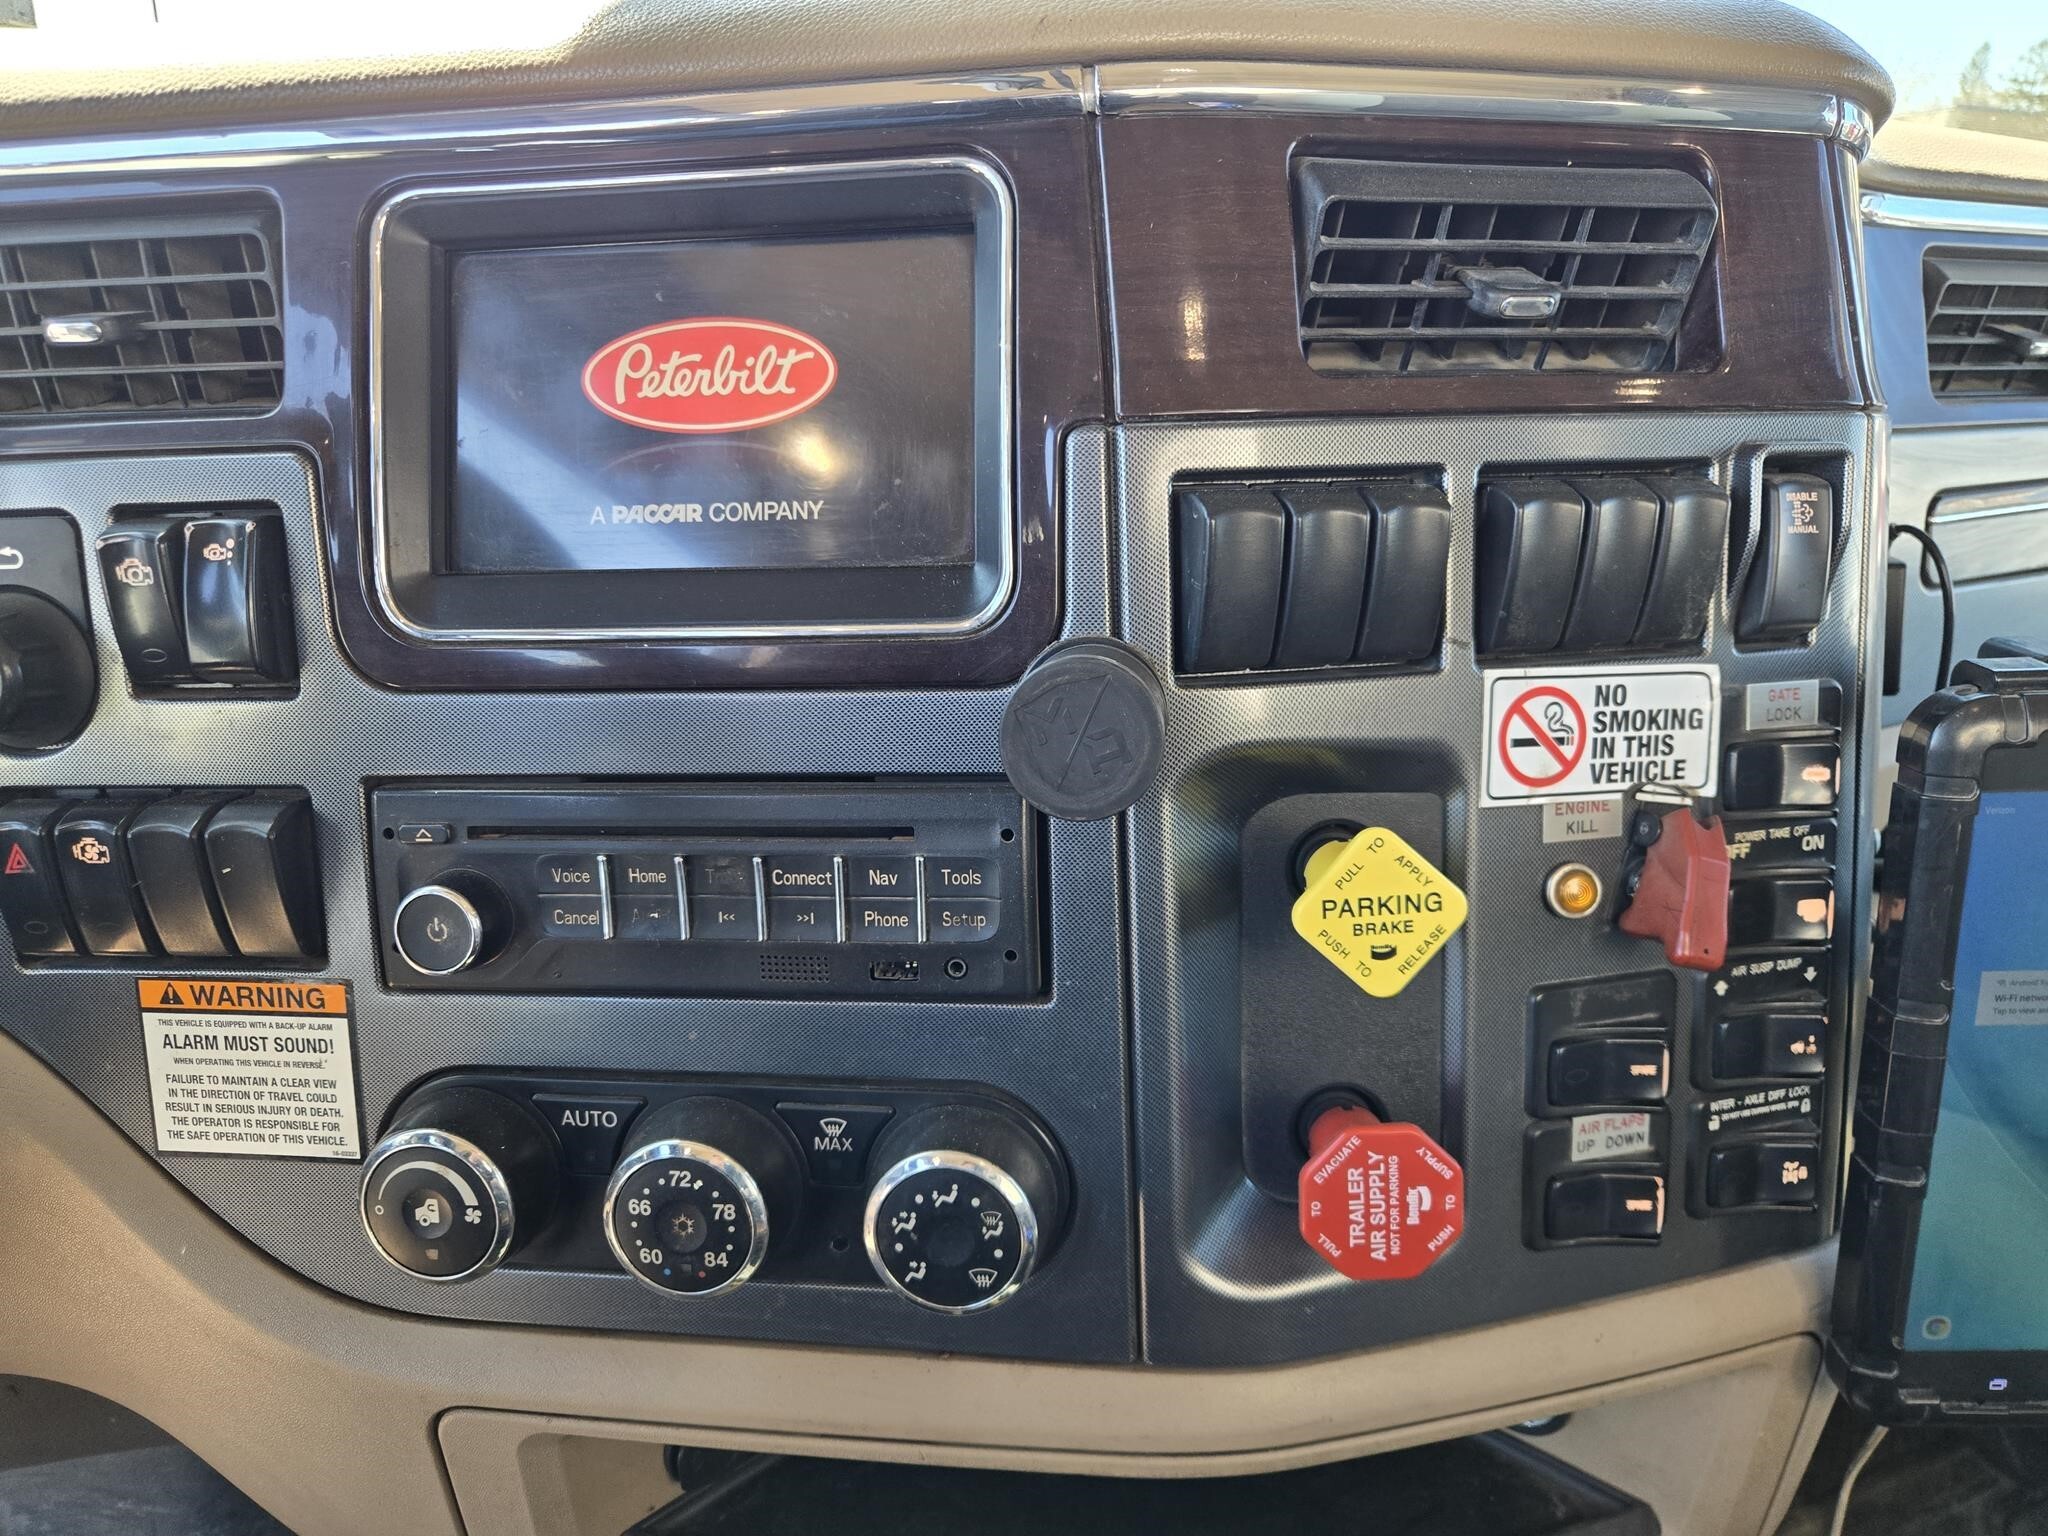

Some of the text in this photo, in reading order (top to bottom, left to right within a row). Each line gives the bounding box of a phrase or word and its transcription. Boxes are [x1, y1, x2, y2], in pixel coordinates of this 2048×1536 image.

[615, 343, 814, 404] Peterbilt
[590, 500, 824, 525] A PACCAR COMPANY
[1787, 525, 1819, 533] MANUAL
[1594, 683, 1627, 707] NO
[1768, 687, 1801, 702] GATE
[1592, 708, 1704, 733] SMOKING
[1766, 707, 1802, 722] LOCK
[1591, 734, 1675, 759] IN THIS
[1589, 759, 1687, 785] VEHICLE
[1555, 800, 1611, 816] ENGINE
[1566, 820, 1599, 835] KILL
[1734, 824, 1811, 842] POWER TAKE OFF
[1802, 834, 1825, 852] ON
[1335, 837, 1433, 890] PULL TO APPLY
[552, 867, 591, 883] Voice
[628, 868, 667, 883] Home
[772, 869, 833, 886] Connect
[869, 869, 898, 885] Nav
[941, 868, 982, 885] Tools
[1322, 892, 1443, 919] PARKING
[554, 909, 600, 926] Cancel
[864, 911, 909, 927] Phone
[942, 913, 987, 929] Setup
[1353, 919, 1414, 937] BRAKE
[1318, 924, 1447, 978] PUSH TO RELEASE
[1731, 965, 1748, 977] AIR
[1776, 957, 1802, 971] DUMP
[189, 984, 326, 1009] WARNING
[158, 1018, 173, 1027] THIS
[175, 1019, 203, 1027] VEHICLE
[213, 1020, 247, 1028] EQUIPPED
[249, 1021, 267, 1029] WITH
[275, 1022, 306, 1030] BACK-UP
[308, 1023, 333, 1031] ALARM
[163, 1033, 334, 1054] ALARM MUST SOUND!
[173, 1057, 194, 1065] WHEN
[195, 1057, 235, 1066] OPERATING
[236, 1059, 252, 1067] THIS
[253, 1059, 283, 1068] VEHICLE
[284, 1060, 291, 1068] IN
[165, 1073, 337, 1089] FAILURE TO MAINTAIN A CLEAR VIEW
[168, 1088, 337, 1103] IN THE DIRECTION OF TRAVEL COULD
[1743, 1091, 1766, 1106] AXLE
[1767, 1088, 1787, 1102] DIFF
[1788, 1084, 1811, 1098] LOCK
[165, 1102, 344, 1118] RESULT IN SERIOUS INJURY OR DEATH.
[171, 1116, 341, 1132] THE OPERATOR IS RESPONSIBLE FOR
[561, 1110, 618, 1129] AUTO
[1578, 1113, 1645, 1136] AIR FLAPS
[167, 1129, 348, 1146] THE SAFE OPERATION OF THIS VEHICLE.
[814, 1136, 854, 1152] MAX
[1576, 1131, 1645, 1154] UP DOWN
[668, 1170, 693, 1188] 72
[1311, 1135, 1362, 1258] PULL TO EVACUATE
[1416, 1146, 1456, 1252] PUSH TO SUPPLY
[628, 1199, 652, 1216] 66
[712, 1204, 736, 1221] 78
[1347, 1167, 1366, 1248] TRAILER
[1368, 1150, 1387, 1262] AIR SUPPLY
[1388, 1155, 1401, 1256] NOT FOR PARKING
[639, 1248, 663, 1265] 60
[704, 1251, 729, 1268] 84
